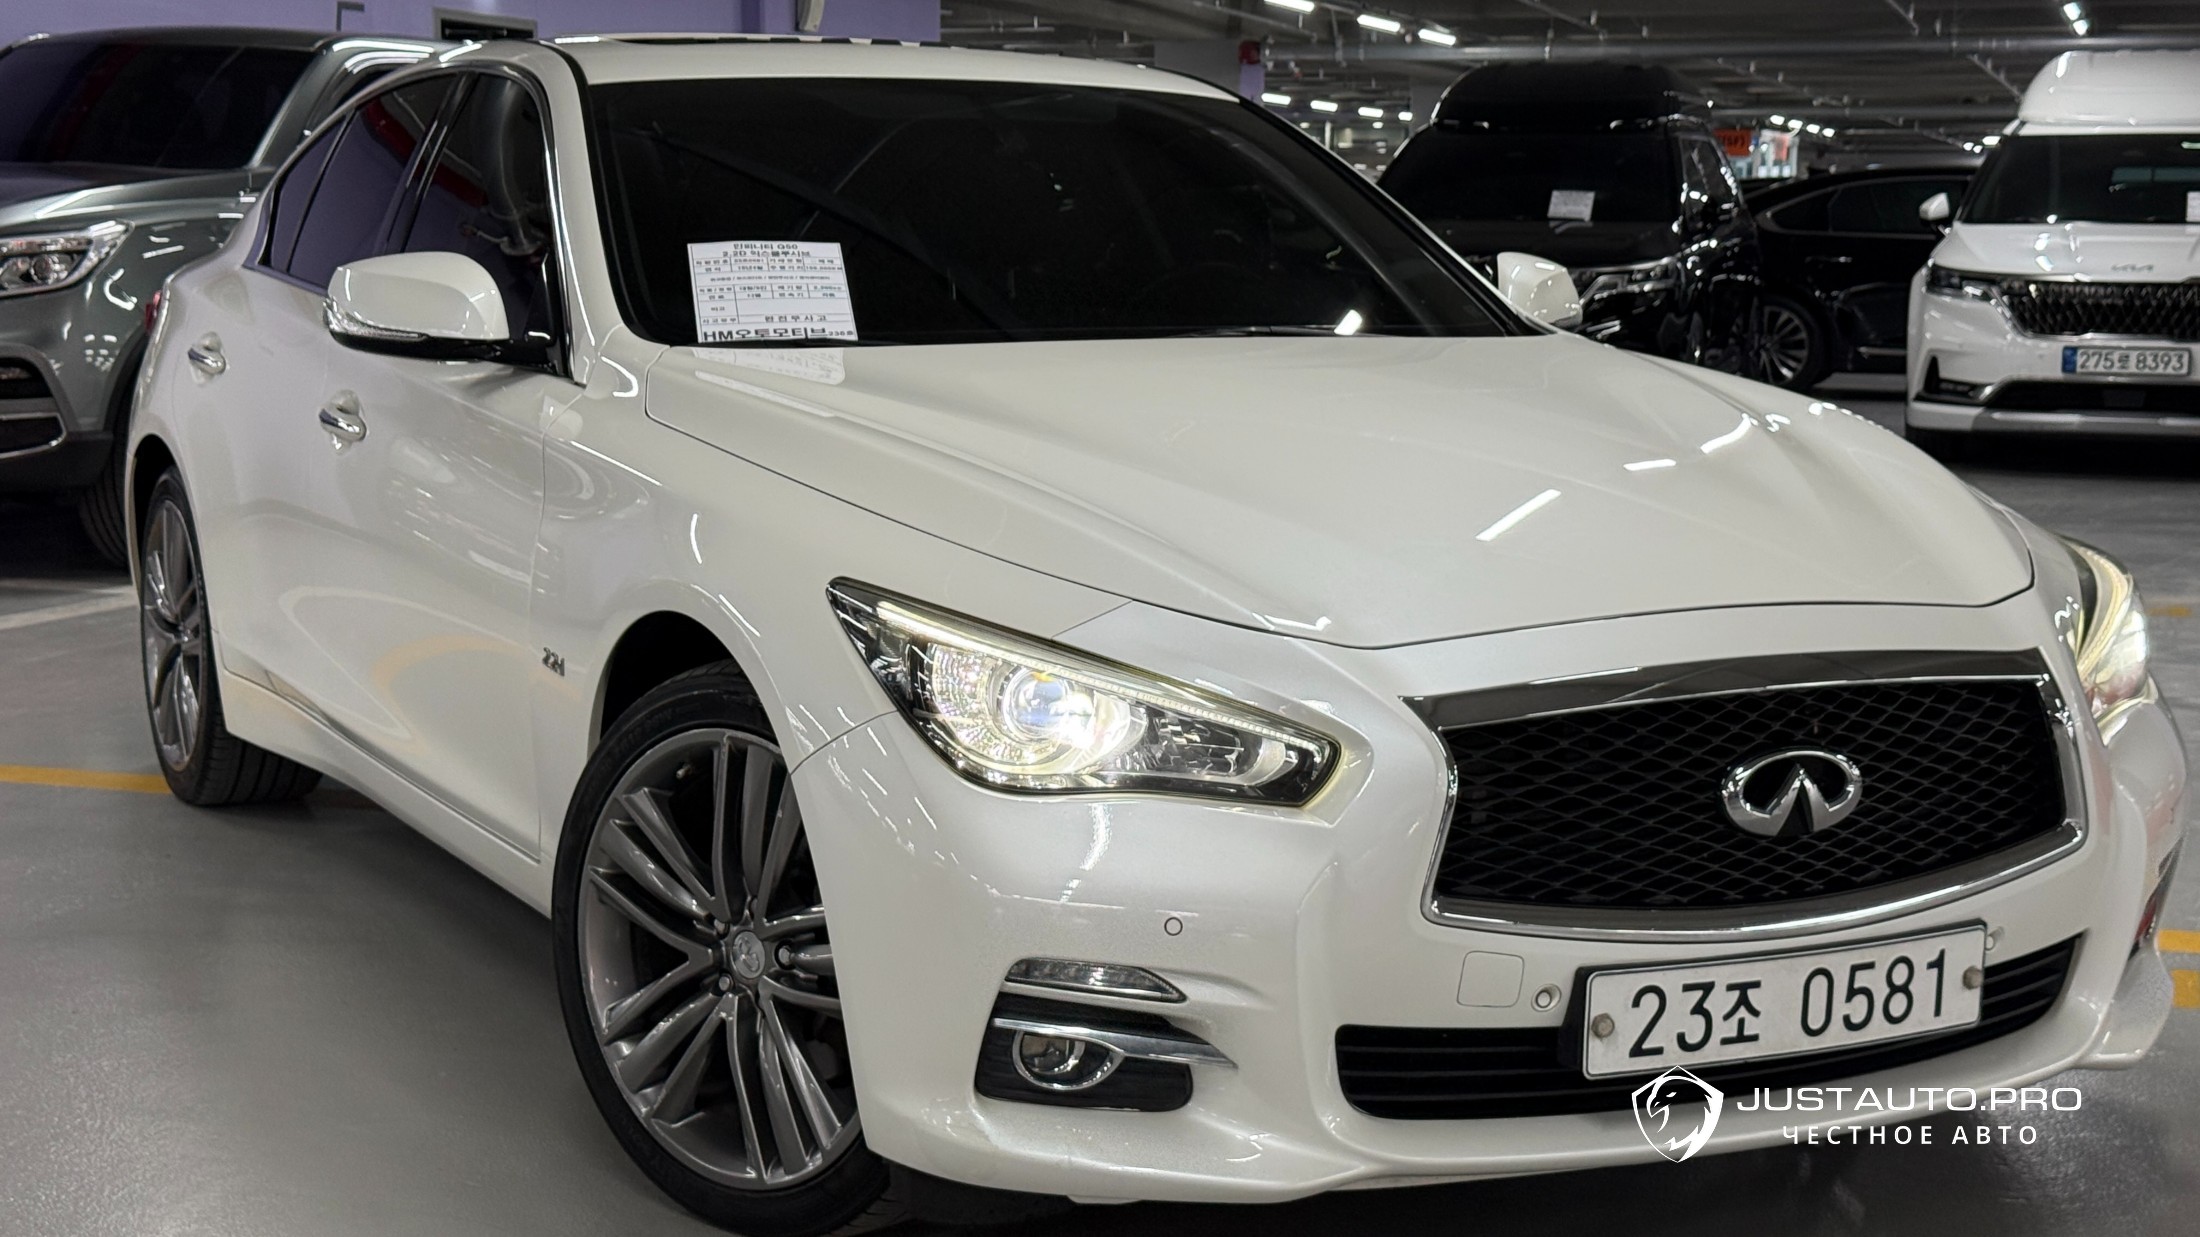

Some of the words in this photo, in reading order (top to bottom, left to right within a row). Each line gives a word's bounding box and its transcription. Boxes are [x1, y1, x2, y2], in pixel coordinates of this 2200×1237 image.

[2136, 351, 2184, 372] 8393
[1628, 979, 1762, 1059] 23조
[1800, 948, 1947, 1038] 0581
